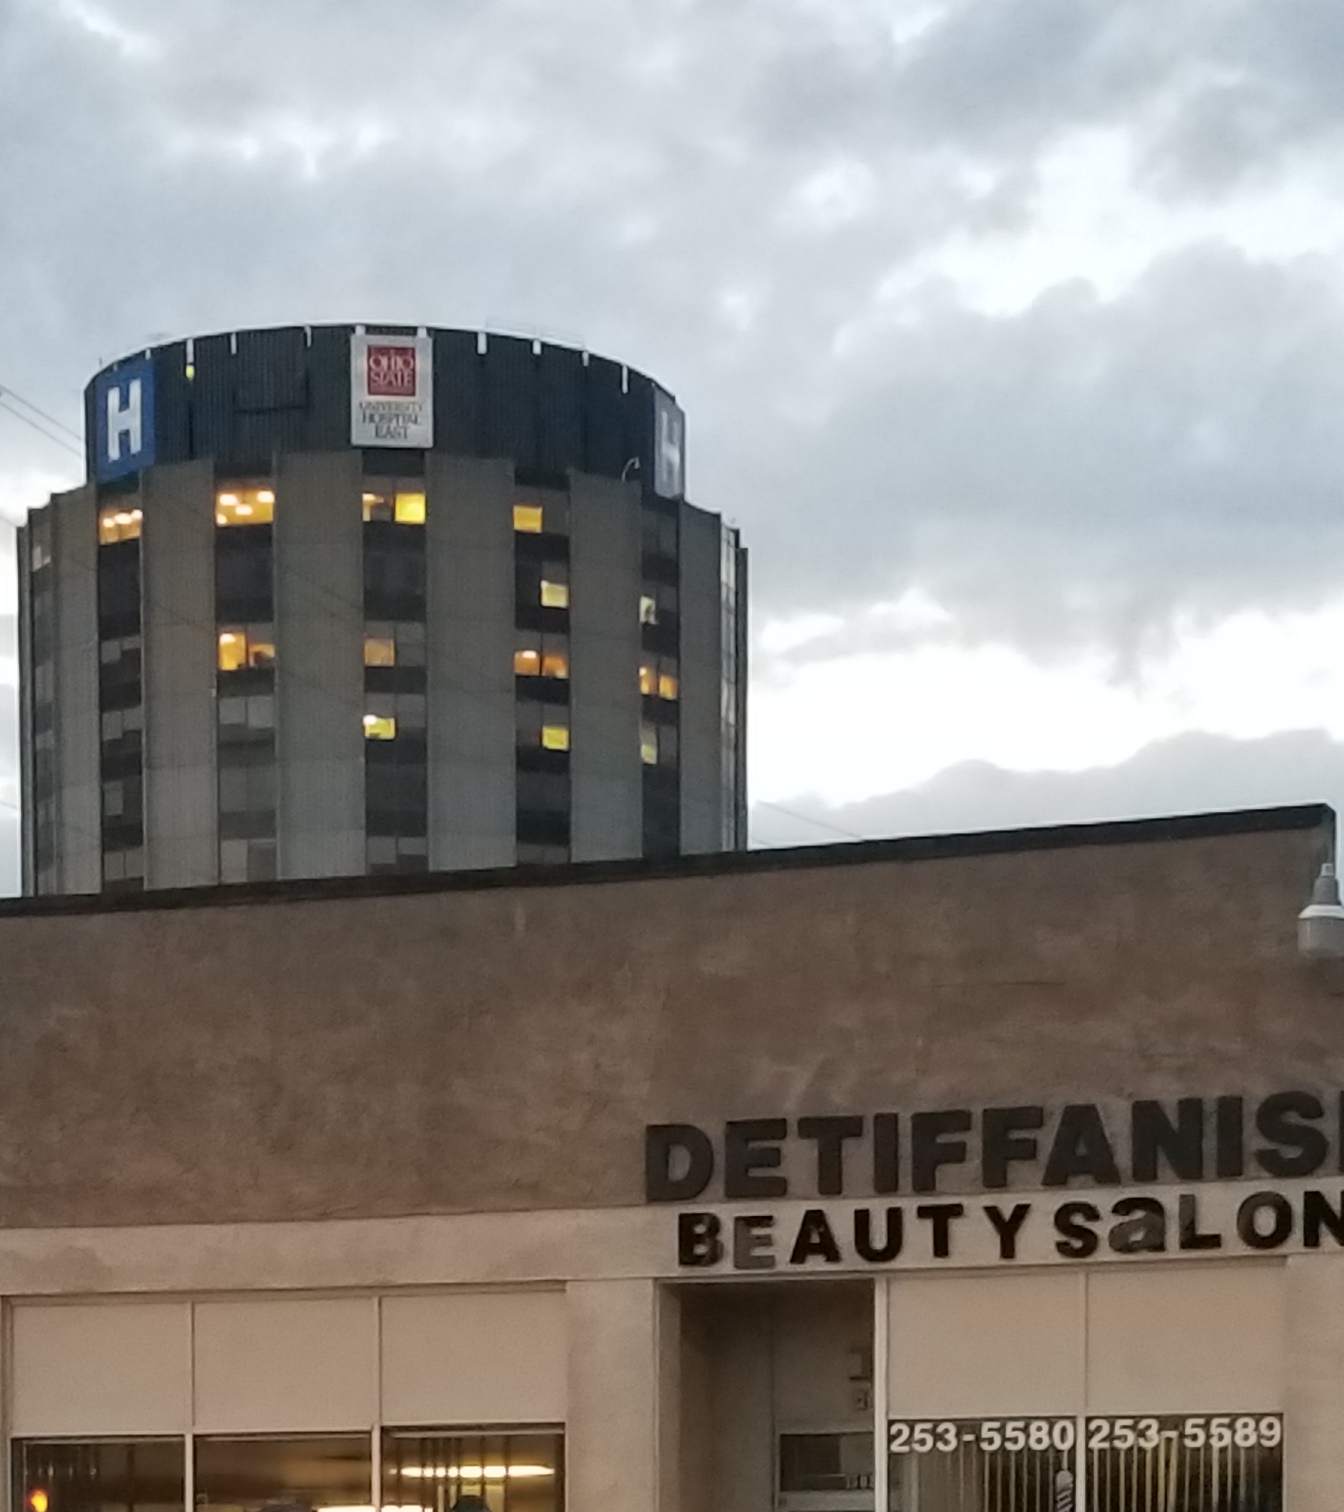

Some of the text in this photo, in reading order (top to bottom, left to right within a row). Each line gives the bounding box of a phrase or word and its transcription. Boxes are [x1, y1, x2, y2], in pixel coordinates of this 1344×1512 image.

[107, 379, 141, 462] H
[375, 424, 408, 439] EAST
[677, 1203, 1031, 1270] BEAUTY
[889, 1421, 1075, 1453] 253-5580
[1087, 1417, 1282, 1448] 253-5589
